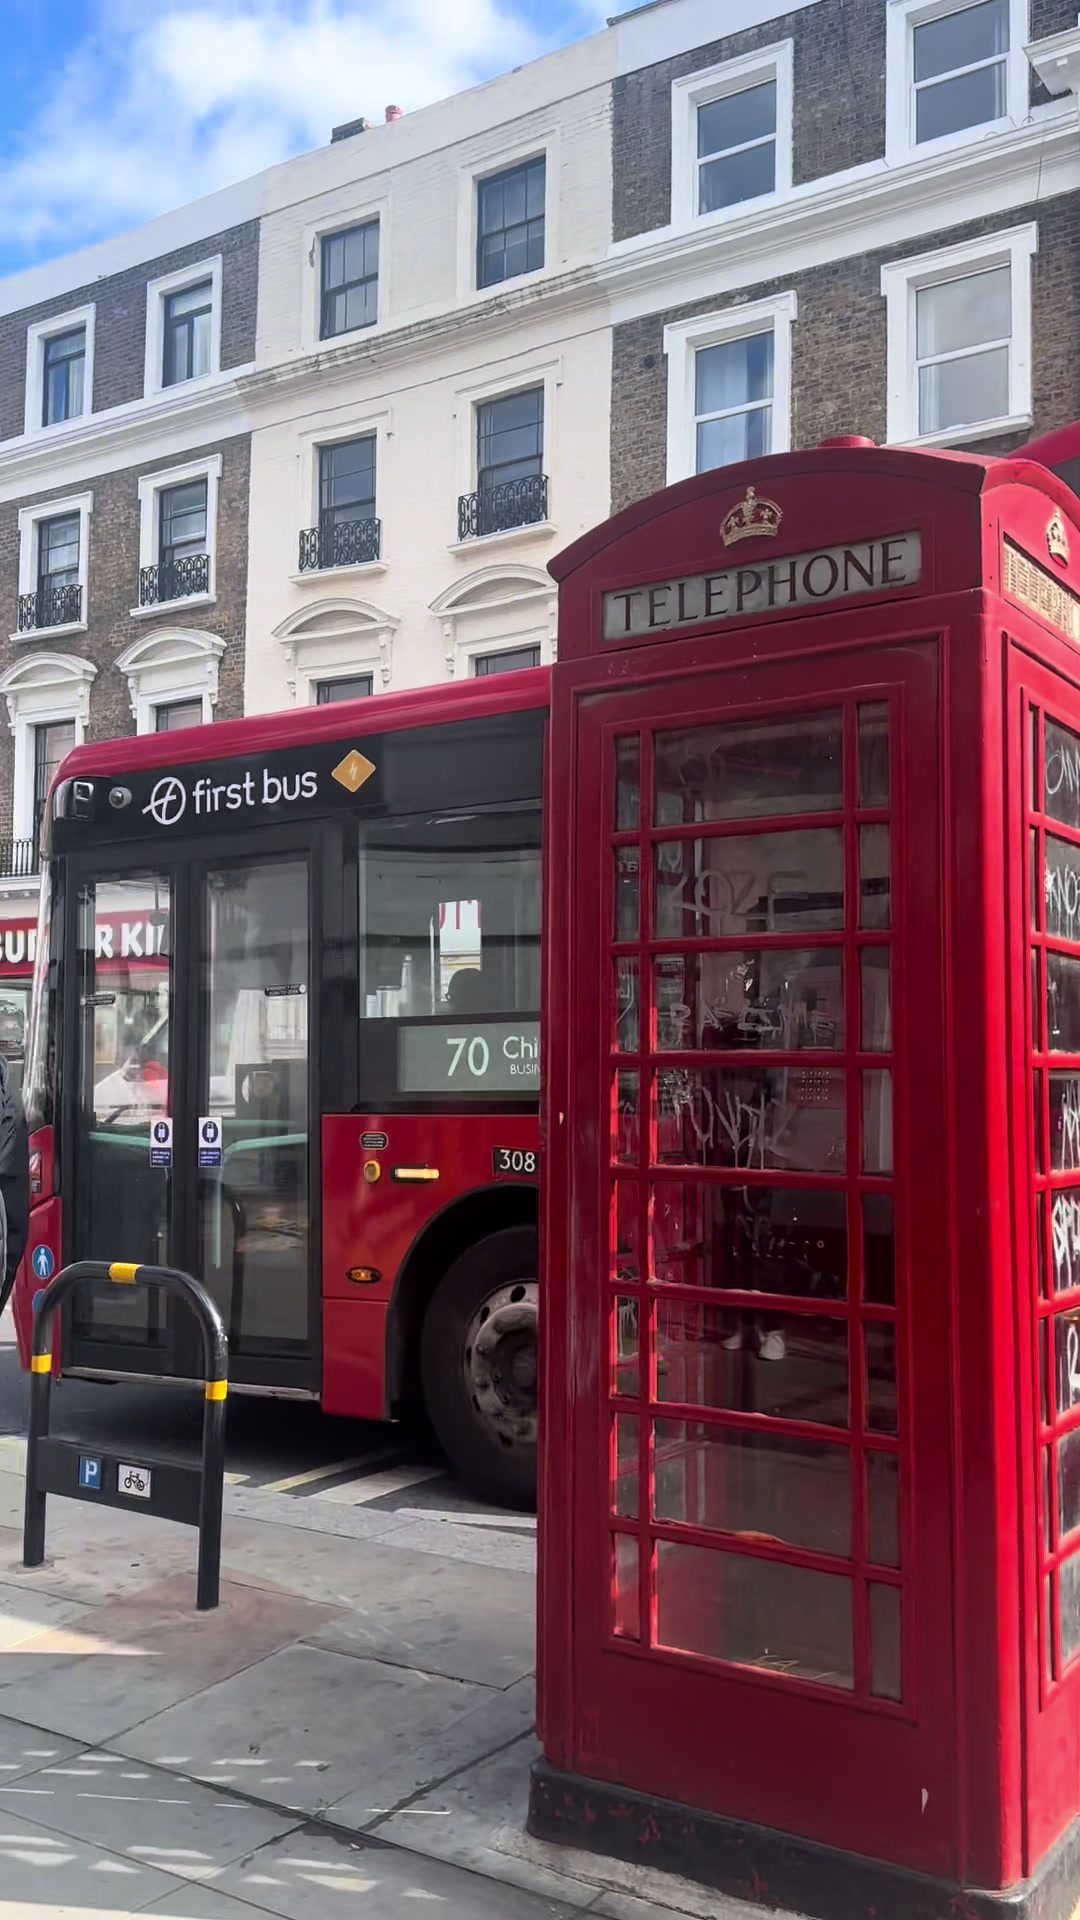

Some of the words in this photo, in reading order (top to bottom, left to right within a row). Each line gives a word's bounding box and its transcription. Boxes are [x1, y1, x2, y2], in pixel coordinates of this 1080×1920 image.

[613, 538, 908, 631] TELEPHONE
[192, 772, 256, 814] first
[261, 768, 318, 804] bus
[446, 1036, 490, 1077] 70
[499, 1149, 536, 1173] 308
[84, 1459, 98, 1484] P
